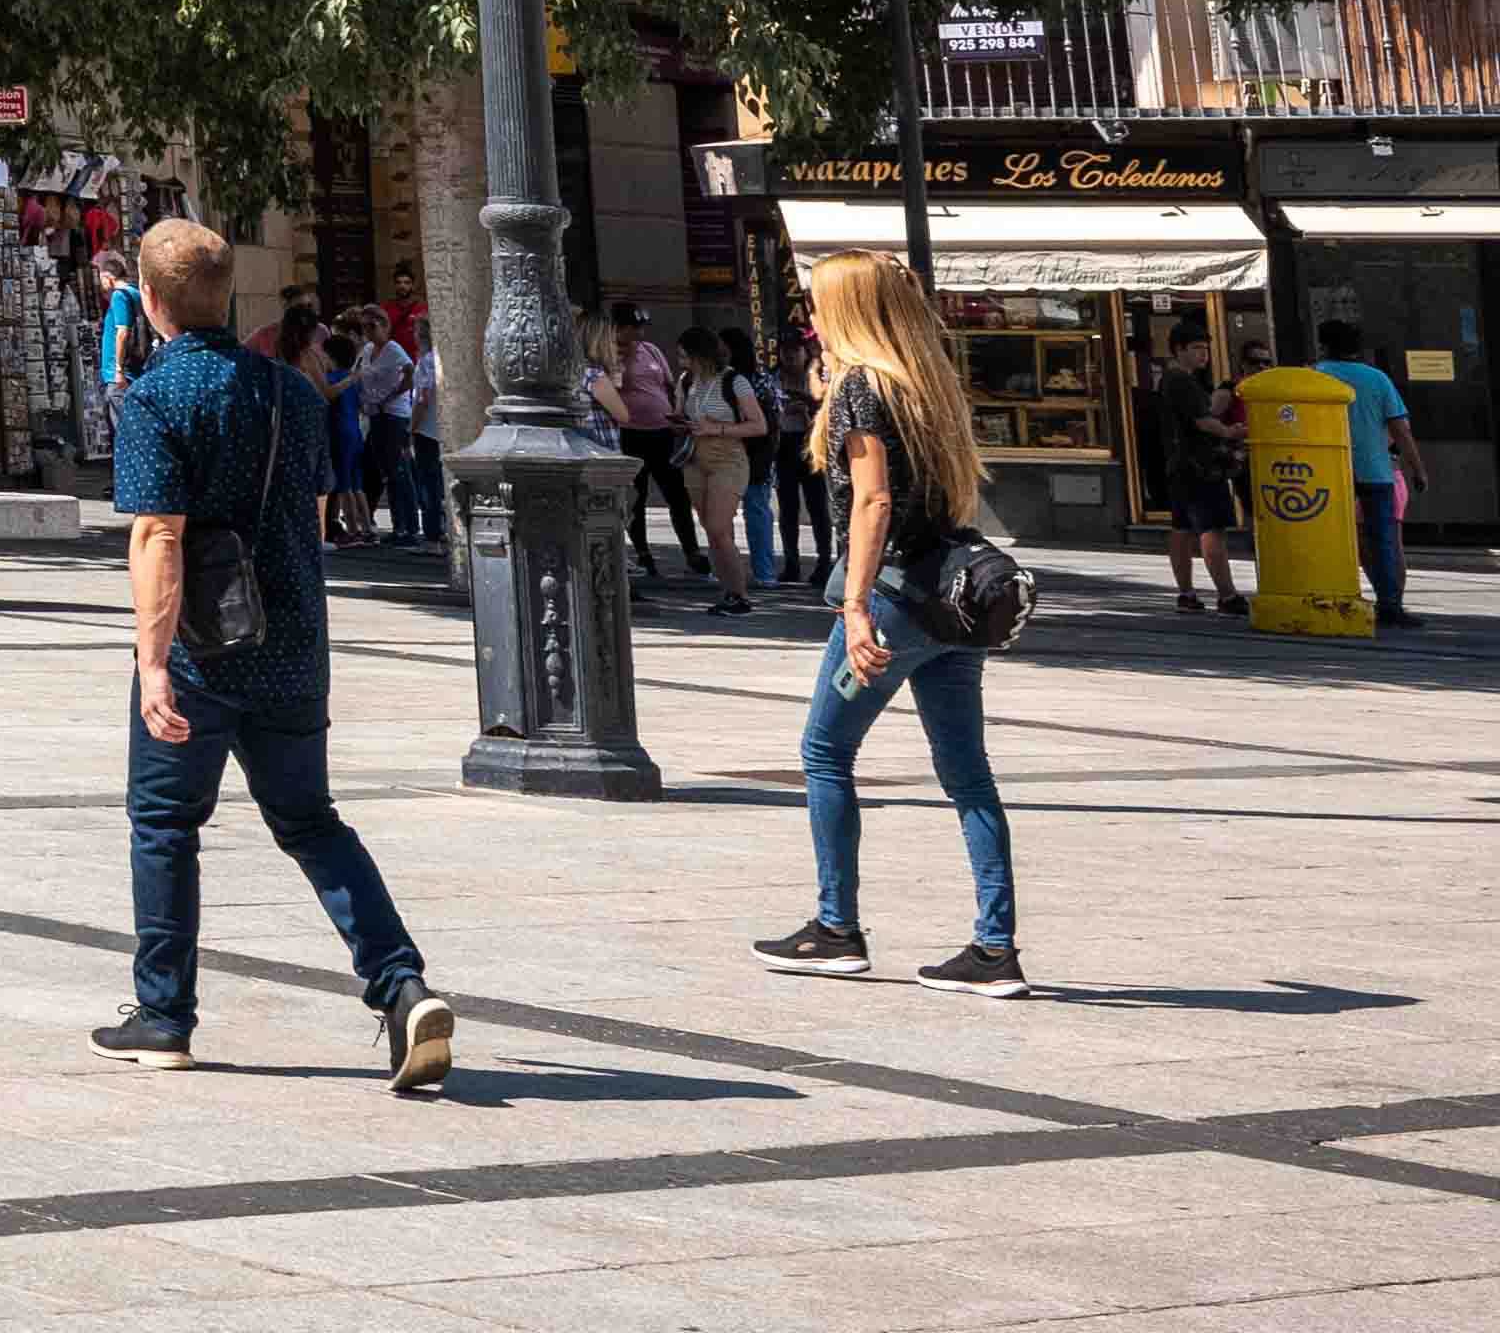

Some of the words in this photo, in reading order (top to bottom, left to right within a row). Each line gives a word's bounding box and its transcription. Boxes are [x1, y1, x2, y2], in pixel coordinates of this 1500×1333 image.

[949, 39, 975, 51] 925
[978, 37, 1005, 50] 298
[1008, 36, 1036, 48] 884
[993, 152, 1058, 189] Los
[1059, 149, 1226, 190] Toledanos
